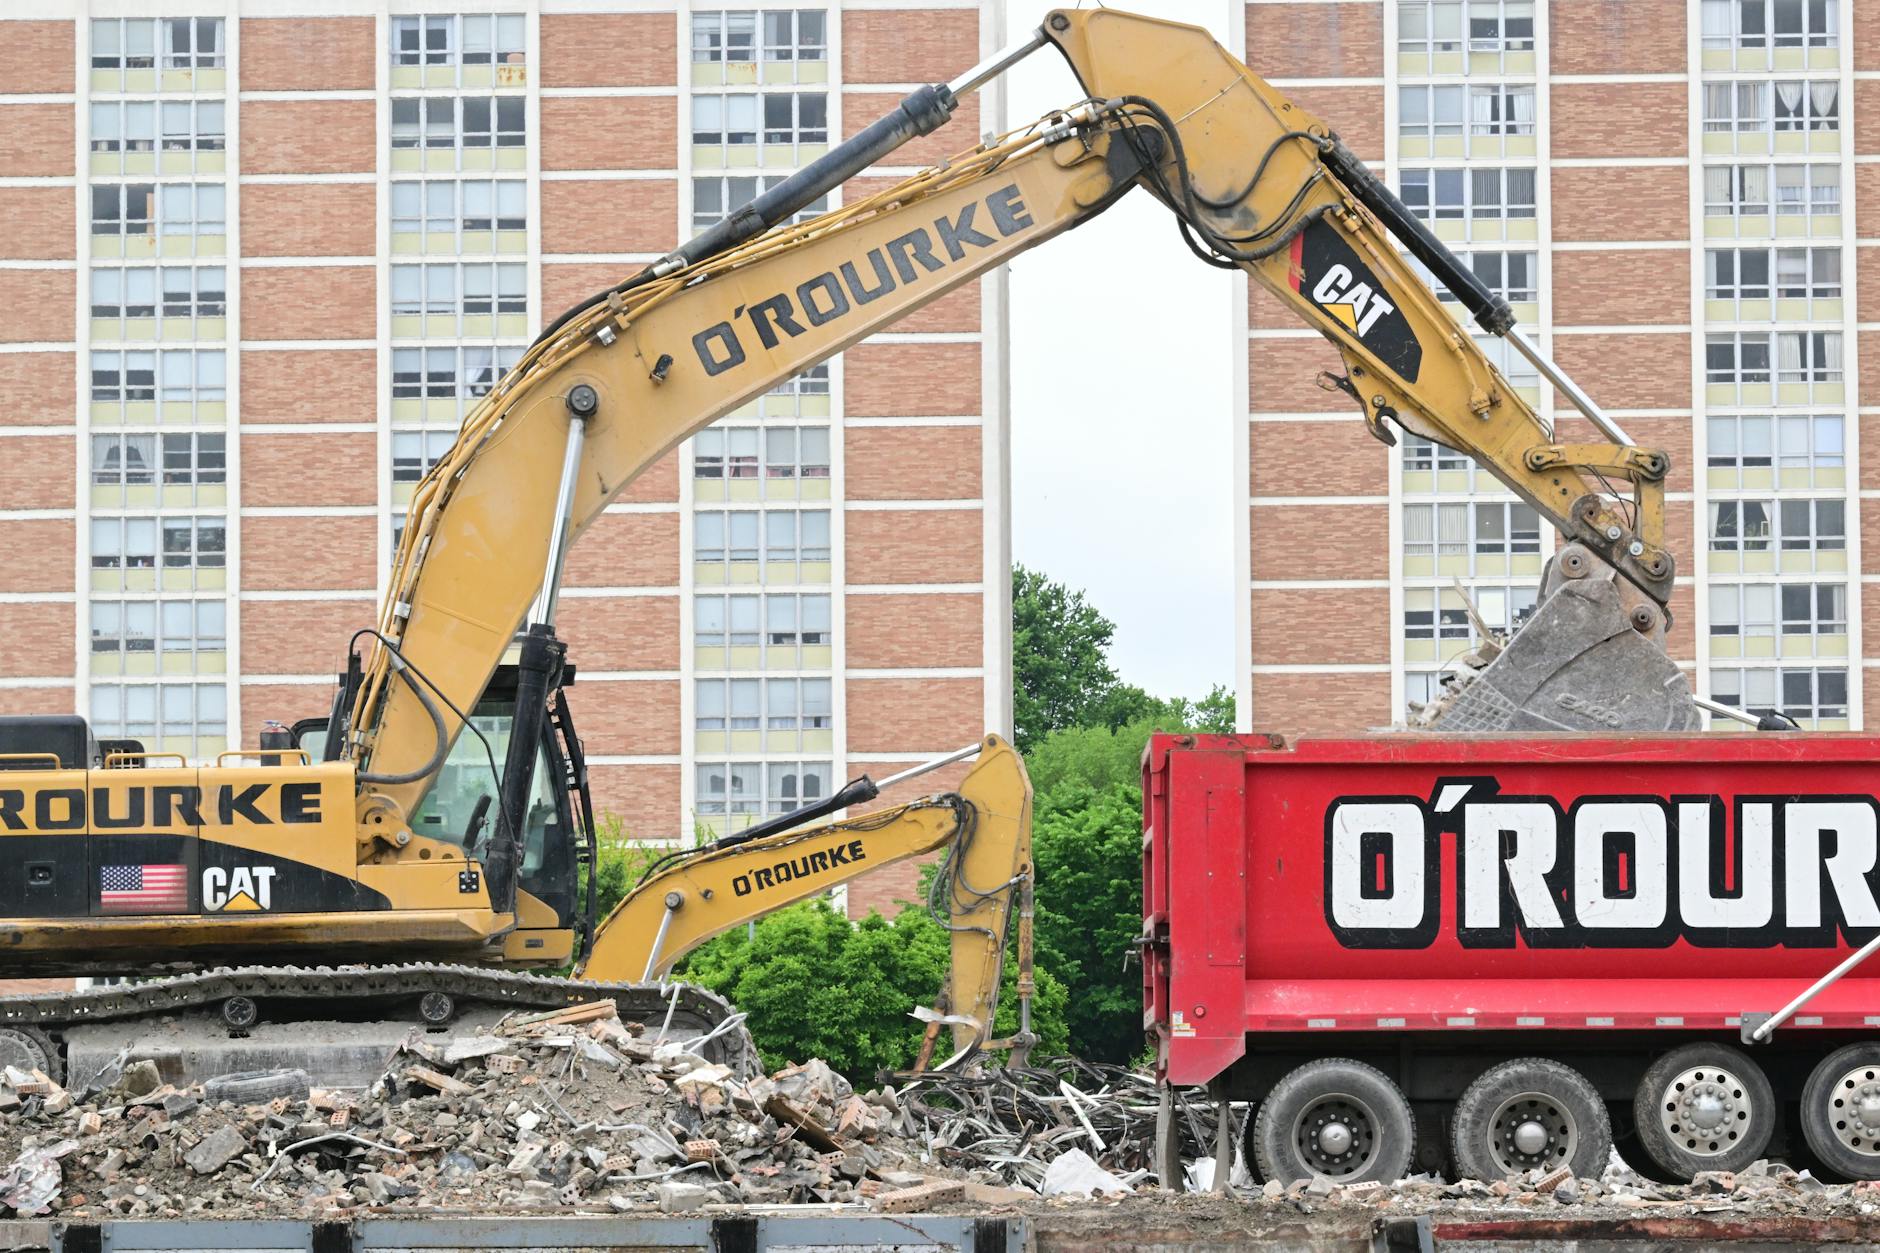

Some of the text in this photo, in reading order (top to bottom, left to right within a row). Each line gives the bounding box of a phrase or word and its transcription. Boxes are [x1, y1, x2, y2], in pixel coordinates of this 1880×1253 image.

[692, 183, 1034, 376] O'ROURKE
[1312, 264, 1394, 338] CAT
[202, 866, 276, 911] CAT
[732, 840, 866, 897] O'ROURKE
[1330, 784, 1880, 929] O'ROUR
